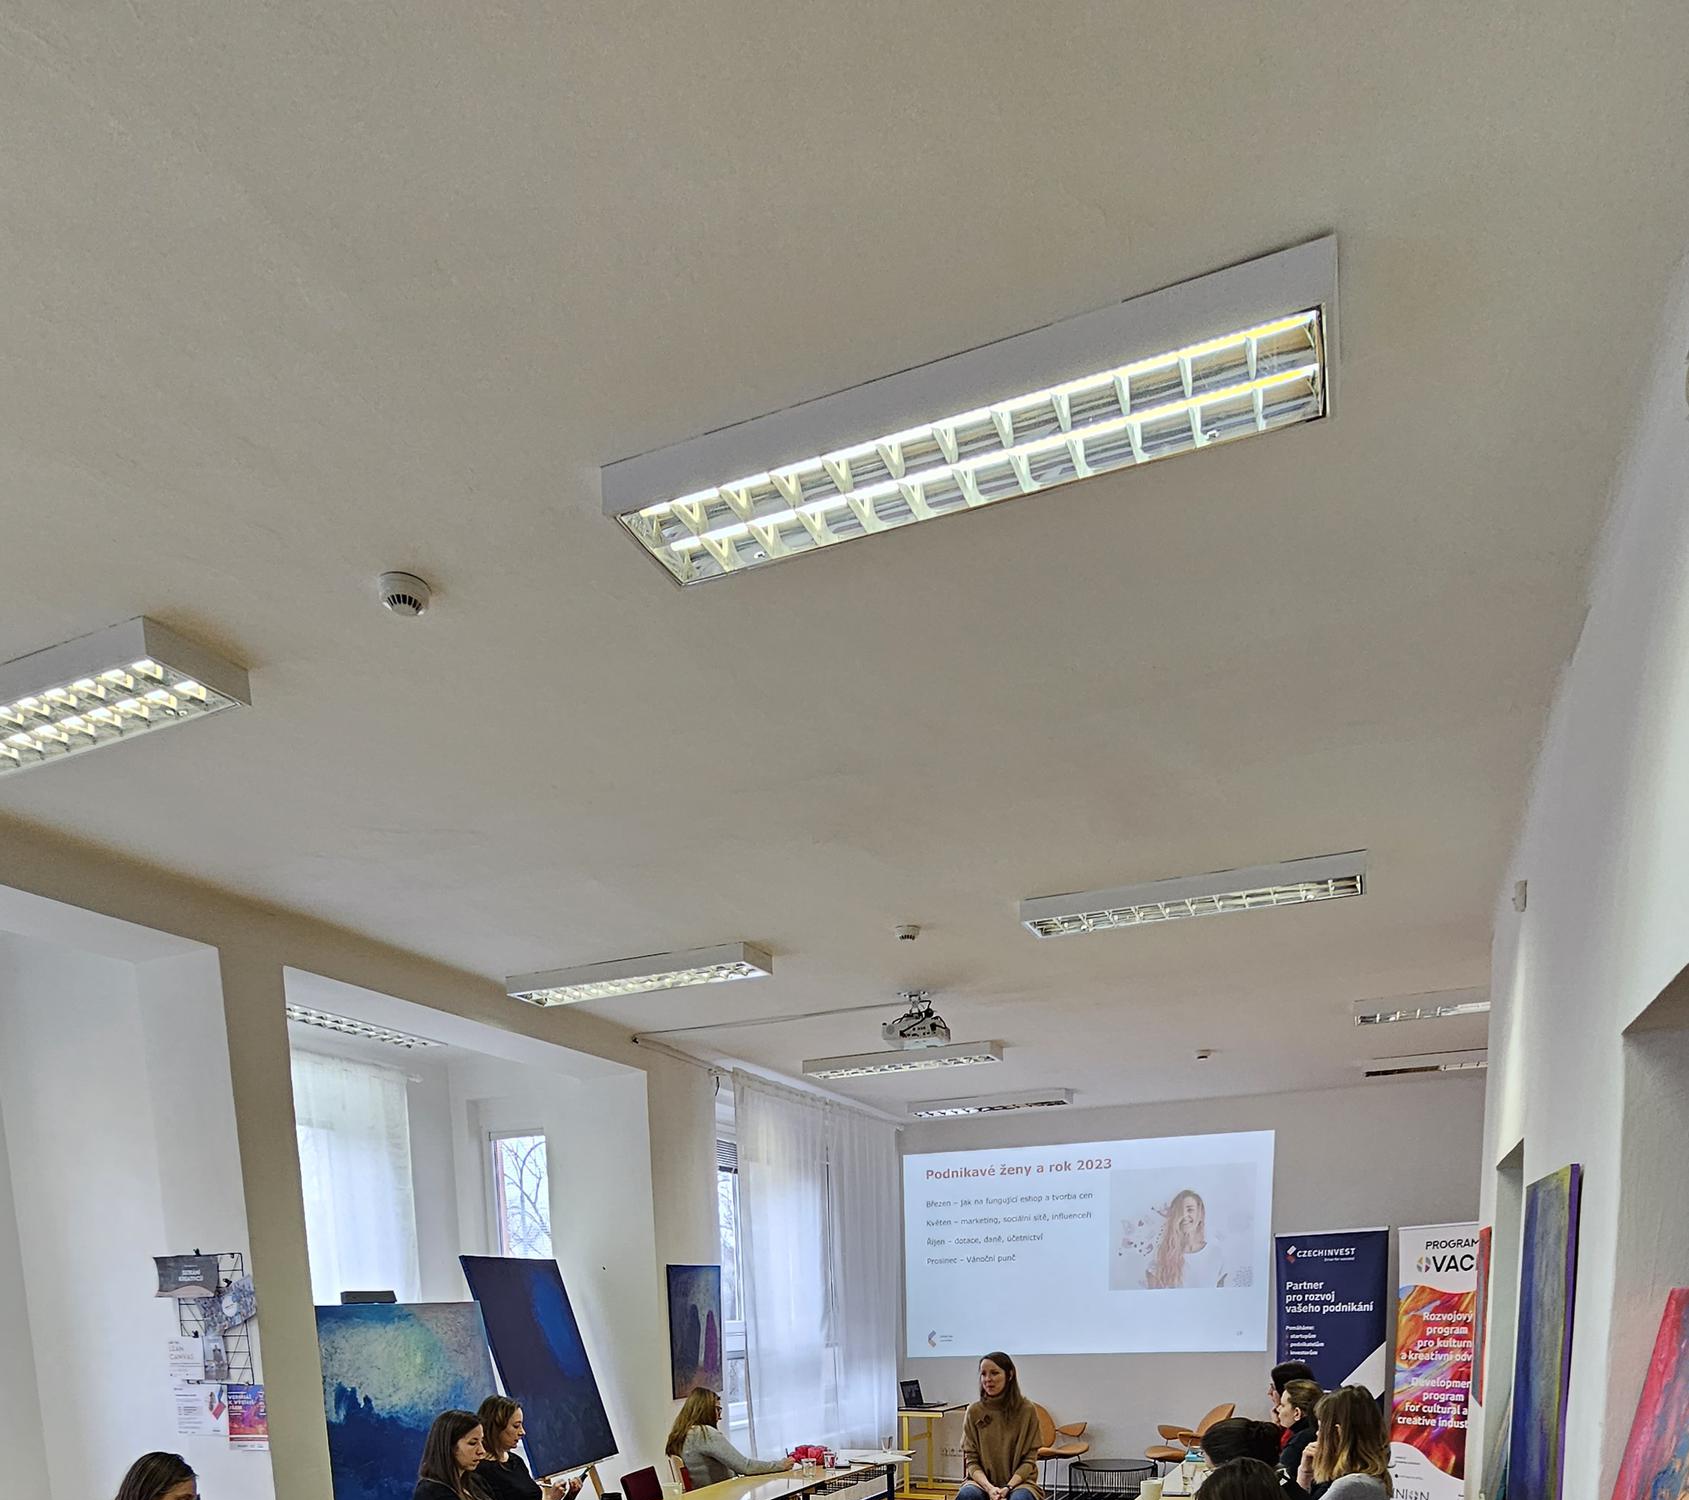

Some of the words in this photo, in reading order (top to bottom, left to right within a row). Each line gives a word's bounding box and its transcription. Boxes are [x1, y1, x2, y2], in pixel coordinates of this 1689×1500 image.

[926, 1164, 996, 1180] Podnikavé
[1000, 1163, 1032, 1177] ženy
[1036, 1164, 1044, 1174] a
[1049, 1160, 1072, 1173] rok
[1077, 1158, 1112, 1171] 2023
[926, 1200, 952, 1208] Březen
[960, 1199, 971, 1207] jak
[1020, 1195, 1043, 1203] eshop
[1052, 1193, 1077, 1201] tvorba
[1079, 1192, 1093, 1200] cen
[926, 1219, 952, 1227] Květen
[997, 1254, 1016, 1262] punč
[1296, 1247, 1356, 1258] CZECHINVEST
[1432, 1253, 1475, 1273] VAC
[1286, 1281, 1324, 1290] Partner
[1285, 1294, 1303, 1304] pro
[1304, 1291, 1335, 1303] rozvoj
[1285, 1302, 1321, 1313] vašeho
[1322, 1300, 1374, 1314] podnikání
[1422, 1311, 1473, 1322] Rozvojový
[1426, 1326, 1469, 1336] program
[1416, 1340, 1435, 1350] pro
[1400, 1352, 1408, 1360] a
[1408, 1350, 1453, 1361] kreativní
[1422, 1392, 1465, 1402] program
[1405, 1402, 1421, 1412] for
[1421, 1404, 1460, 1415] cultural
[1397, 1416, 1437, 1427] creative
